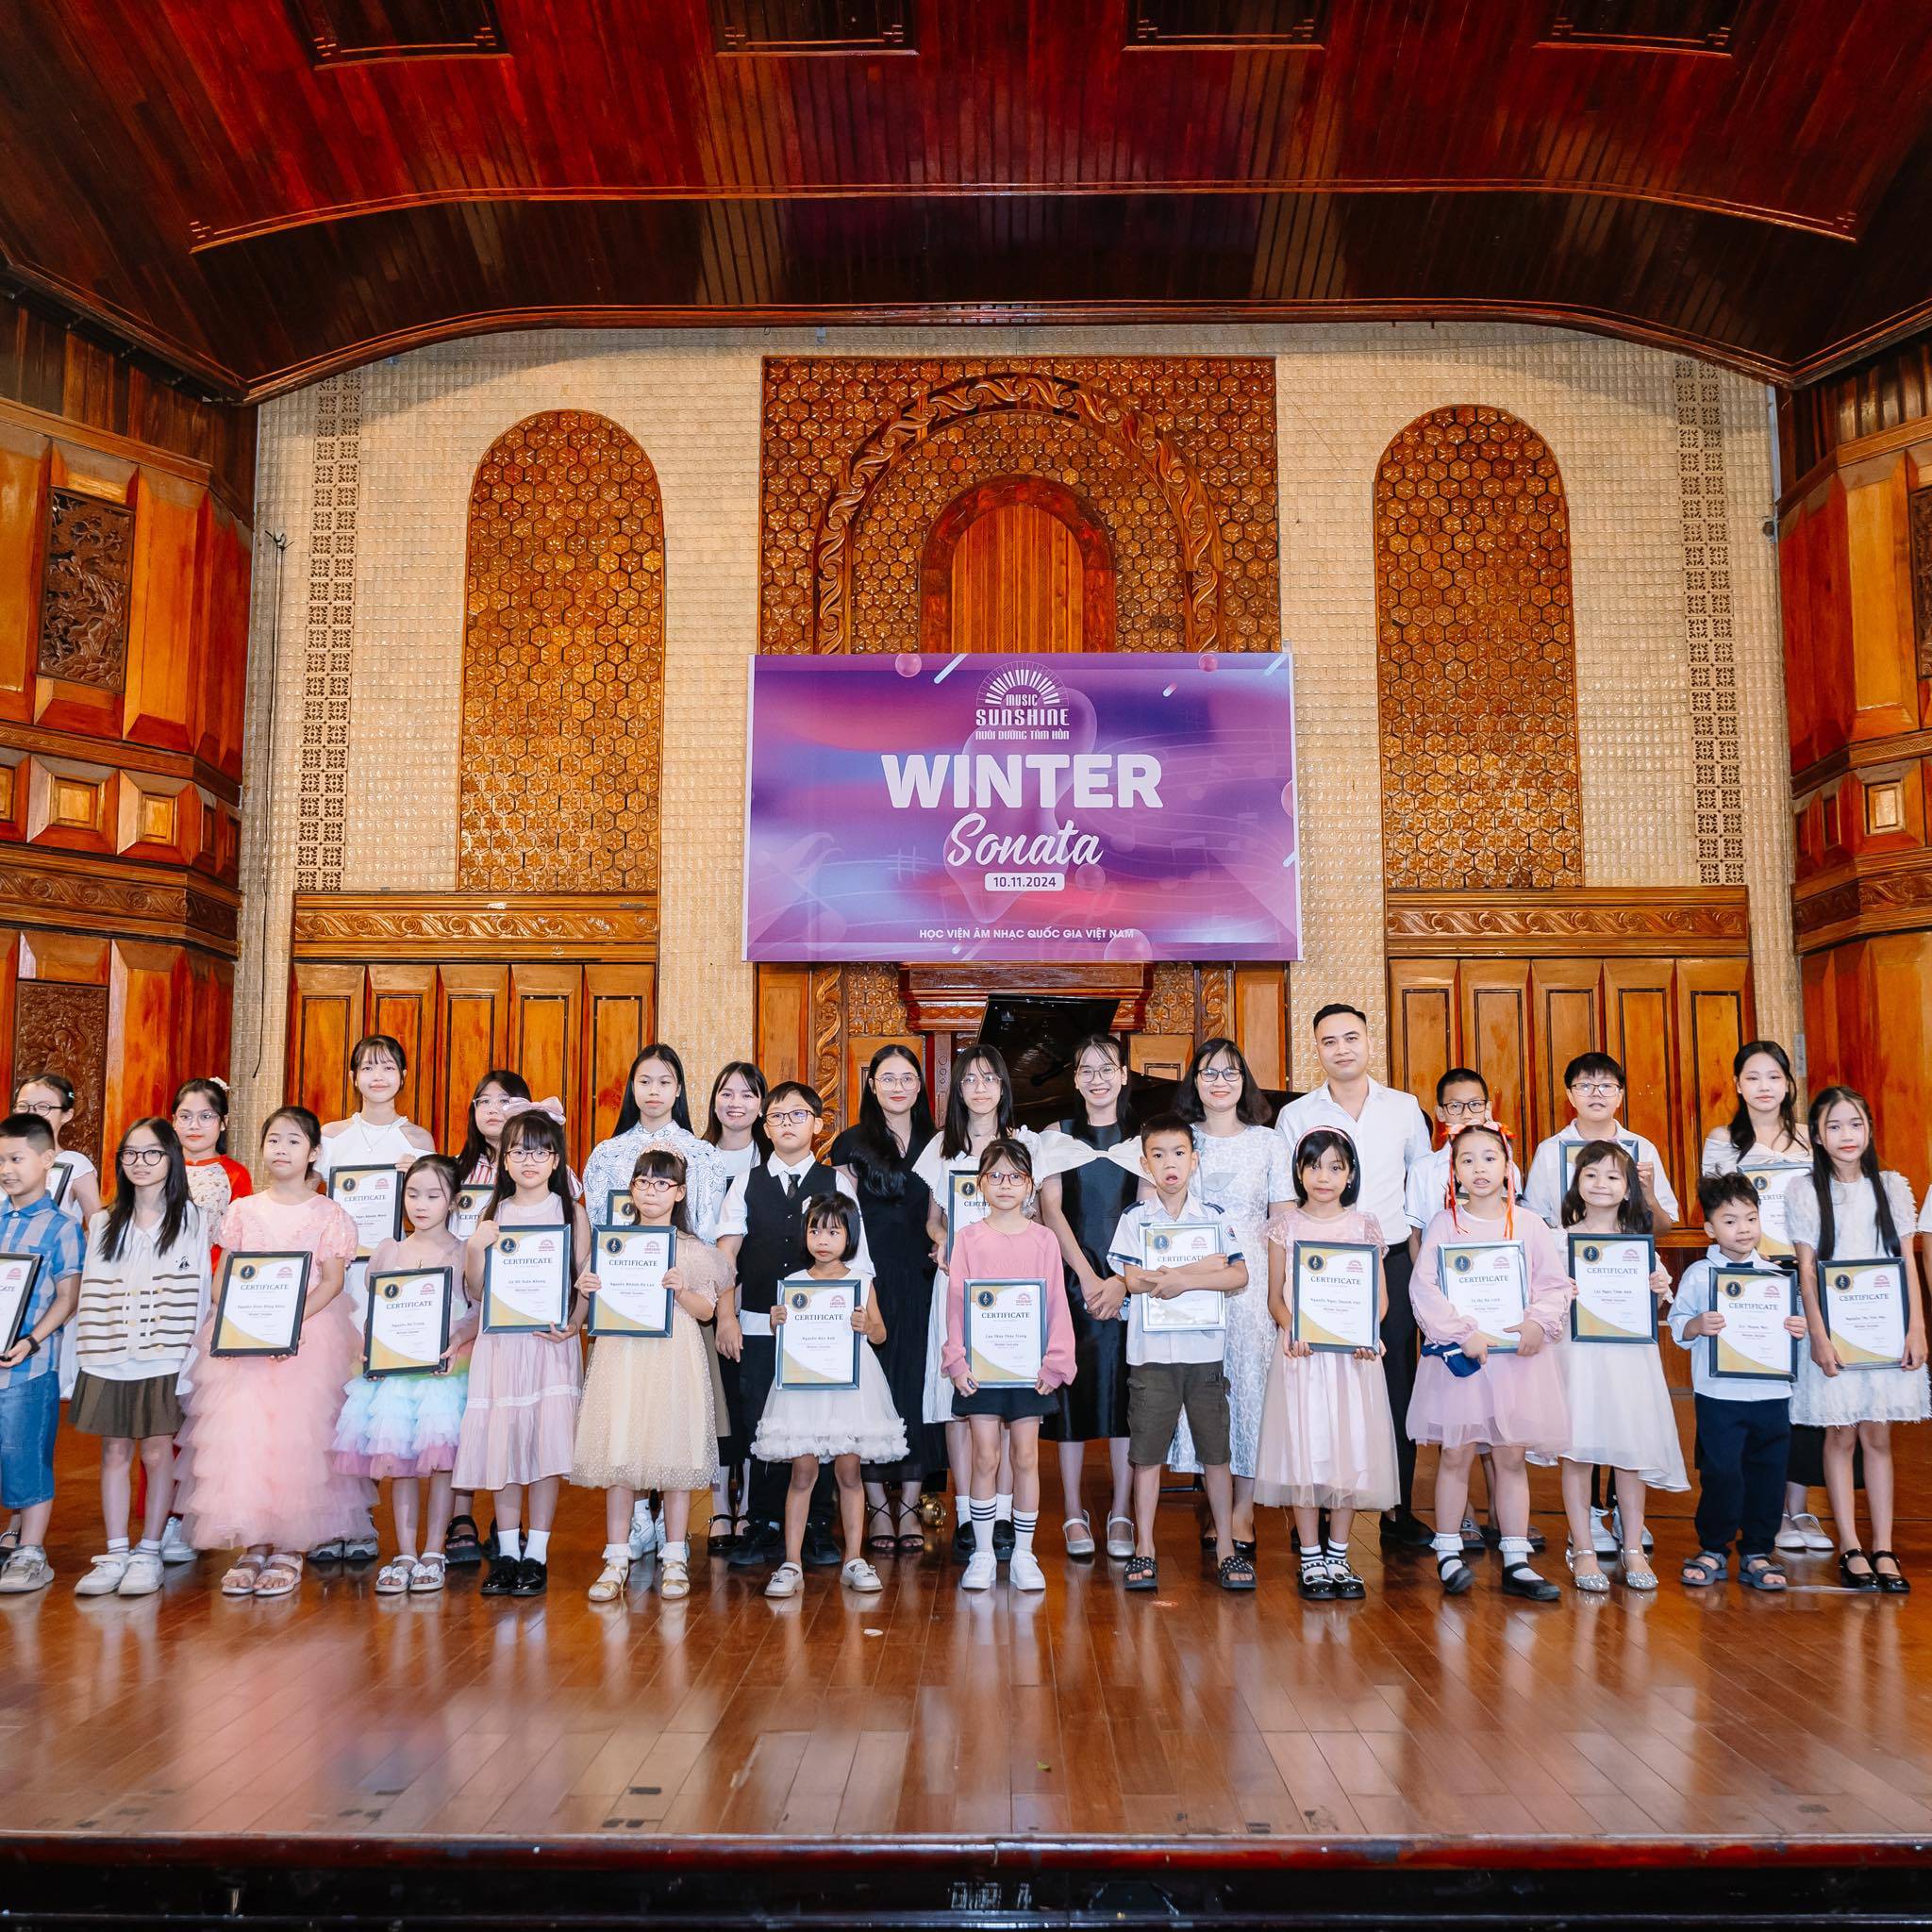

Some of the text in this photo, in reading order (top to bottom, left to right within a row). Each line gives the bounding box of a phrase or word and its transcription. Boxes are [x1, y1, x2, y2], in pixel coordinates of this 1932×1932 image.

[1006, 693, 1038, 707] MUSIC
[975, 708, 1070, 725] SUNSHINE
[880, 754, 1164, 808] WINTER
[946, 812, 1104, 867] Sonata
[993, 876, 1057, 888] 10.11.2024
[919, 926, 1134, 941] HỌC VIỆN ÂM NHẠC QUỐC GIA VIỆT NAM
[1310, 1275, 1361, 1285] CERTIFICATE
[1458, 1274, 1509, 1284] CERTIFICATE
[1840, 1293, 1890, 1302] CERTIFICATE
[386, 1300, 432, 1309] CERTIFICATE
